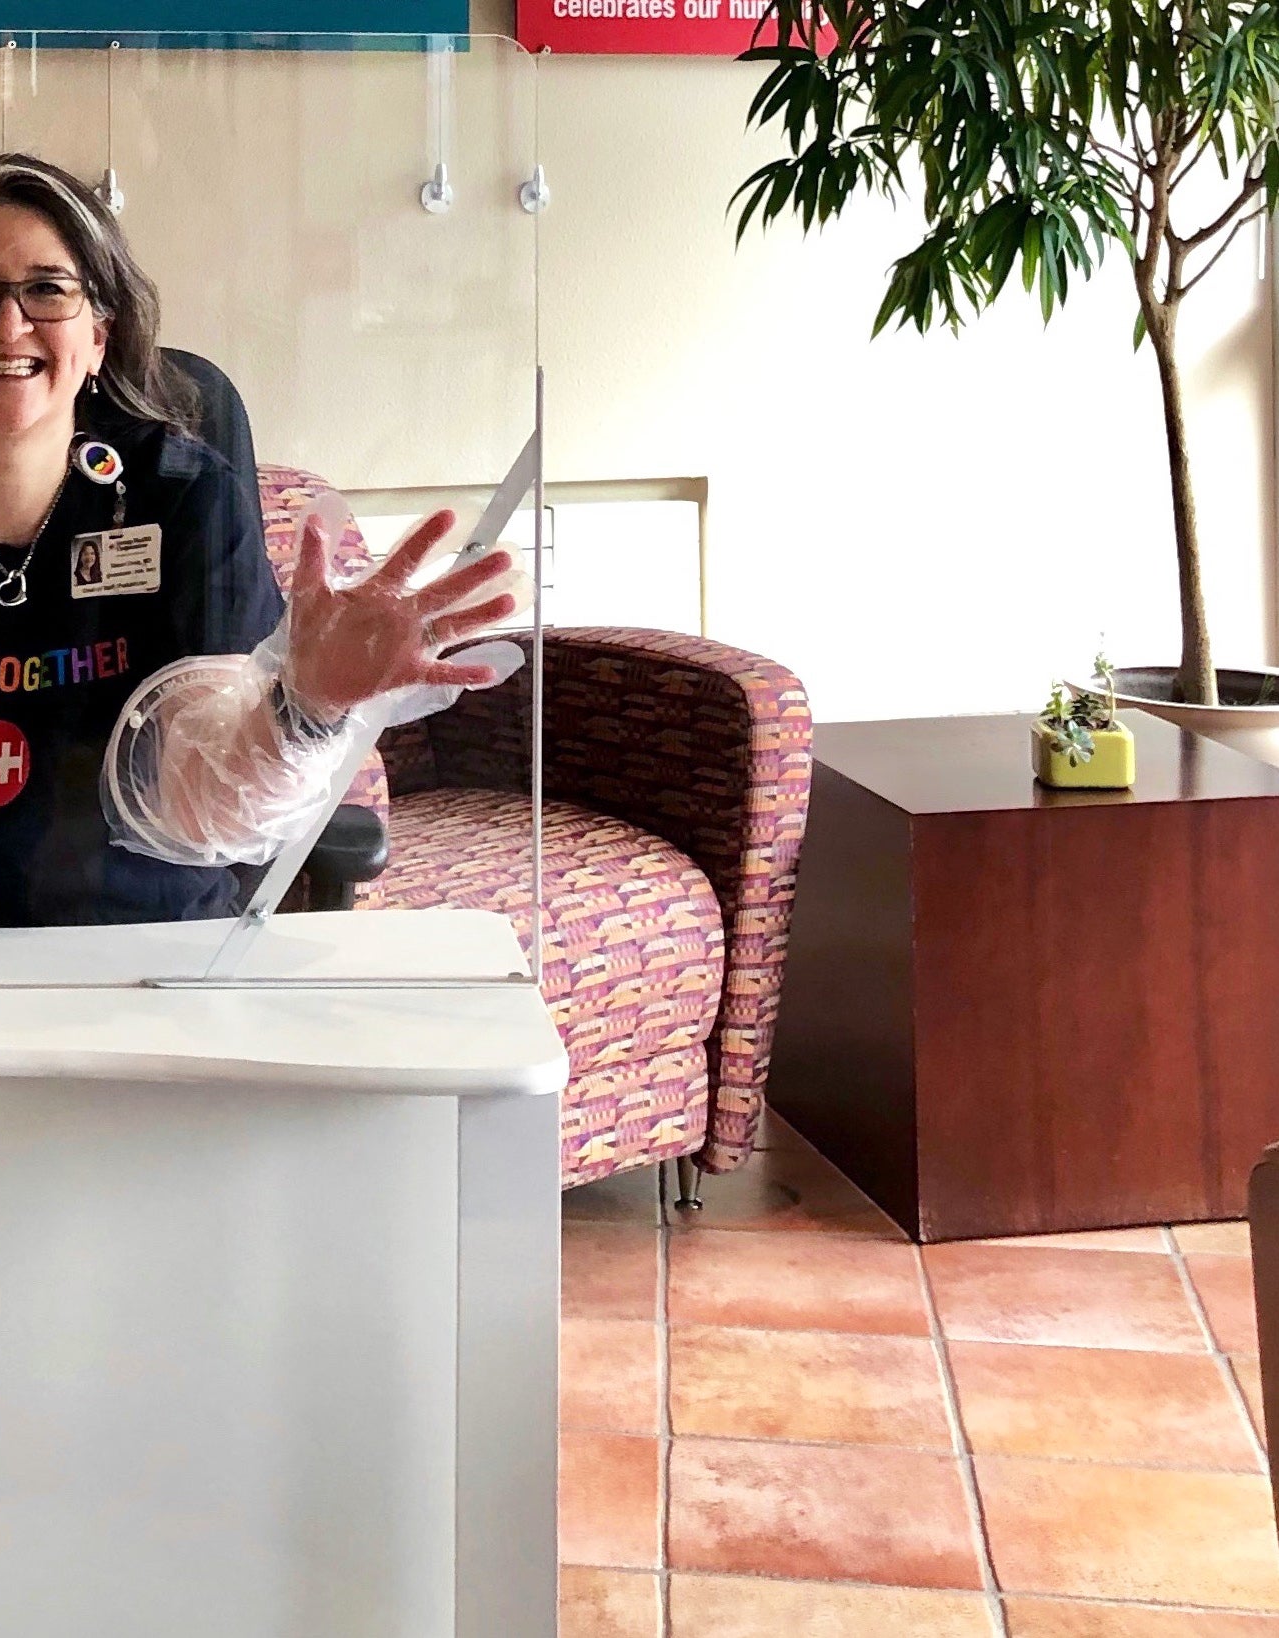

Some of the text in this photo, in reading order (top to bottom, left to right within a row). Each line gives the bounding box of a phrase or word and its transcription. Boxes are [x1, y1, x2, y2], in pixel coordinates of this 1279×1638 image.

[553, 0, 830, 27] celebrates our humi
